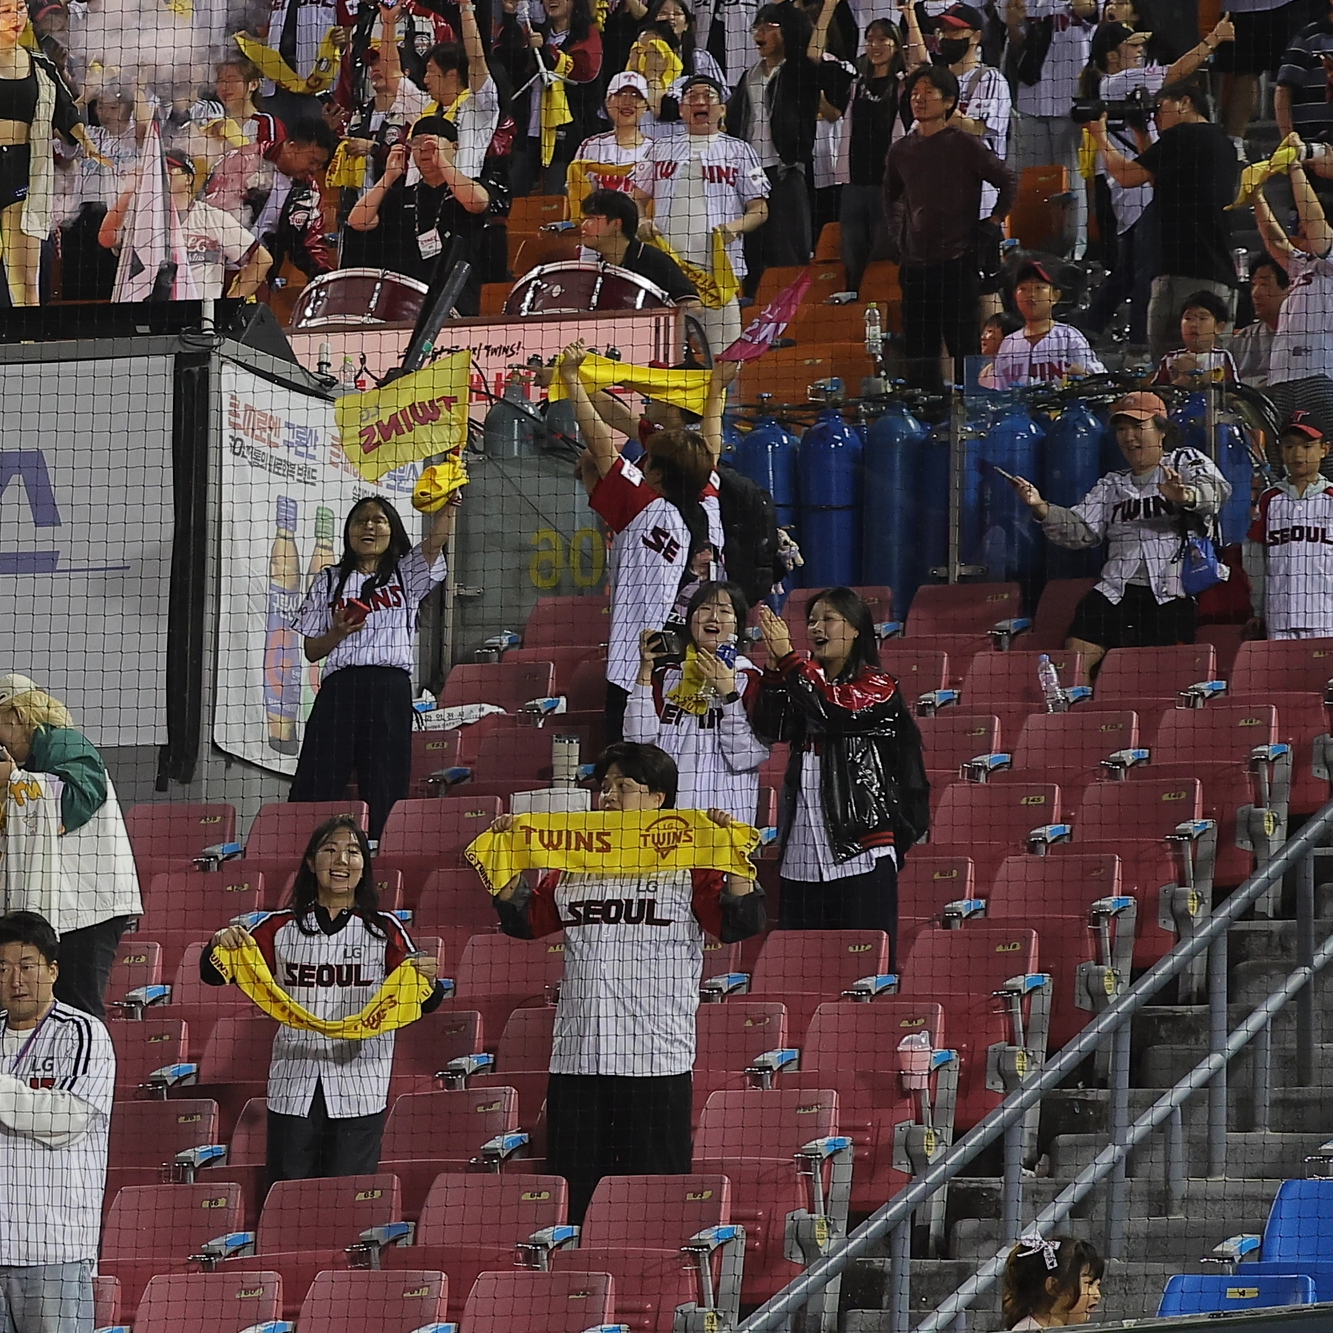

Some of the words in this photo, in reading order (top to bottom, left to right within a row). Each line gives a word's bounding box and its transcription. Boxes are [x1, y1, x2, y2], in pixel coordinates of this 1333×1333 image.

[483, 341, 522, 357] TWINS!
[1110, 495, 1171, 524] TWIN
[519, 825, 613, 853] TWINS
[639, 829, 694, 847] TWINS
[636, 880, 659, 894] LG
[562, 898, 675, 927] SEOUL
[343, 947, 362, 959] LG
[284, 963, 374, 988] SEOUL
[32, 1058, 54, 1072] LG
